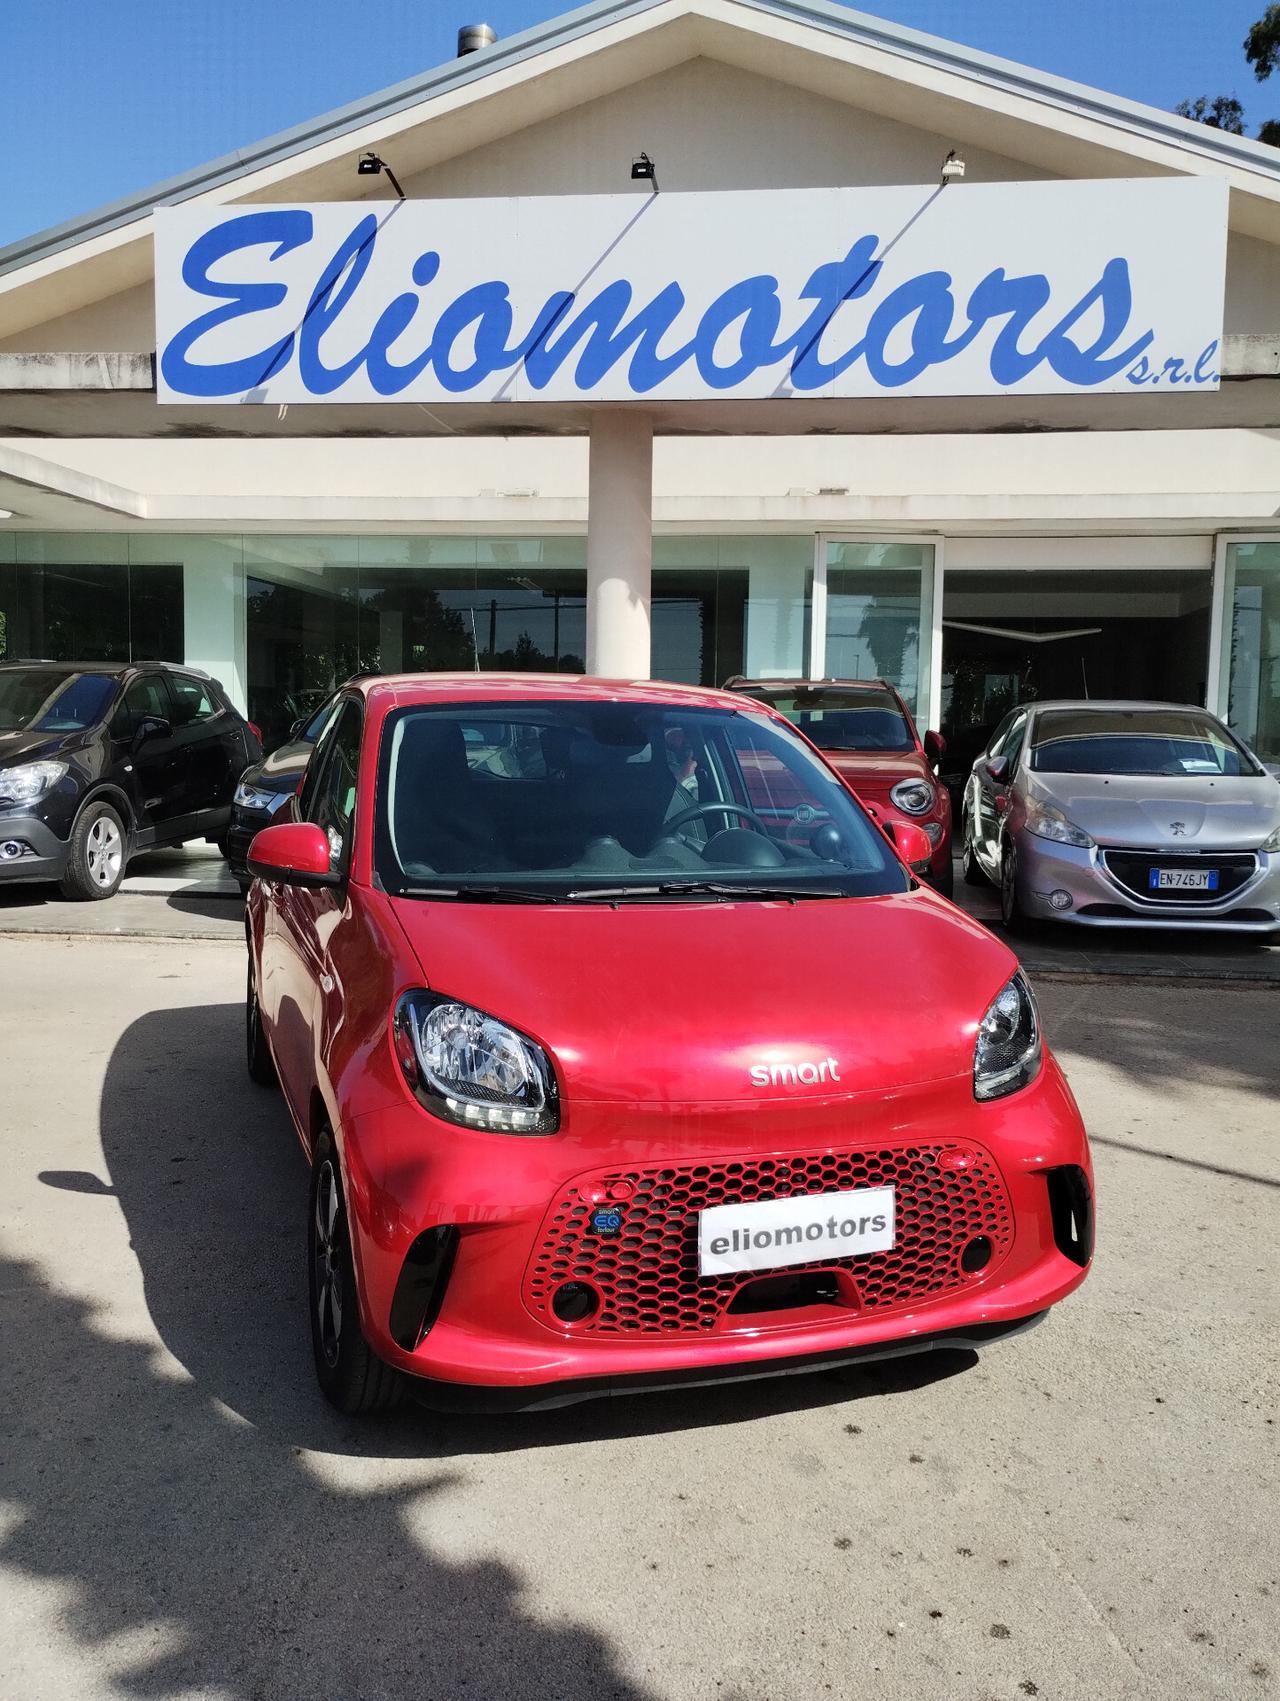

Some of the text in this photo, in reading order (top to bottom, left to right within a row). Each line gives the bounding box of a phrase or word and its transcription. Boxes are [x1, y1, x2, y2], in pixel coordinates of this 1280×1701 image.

[161, 210, 1220, 396] Eliomotors s.r.l.
[750, 1057, 841, 1087] smart
[594, 1215, 619, 1227] EQ
[709, 1214, 887, 1255] eliomotors
